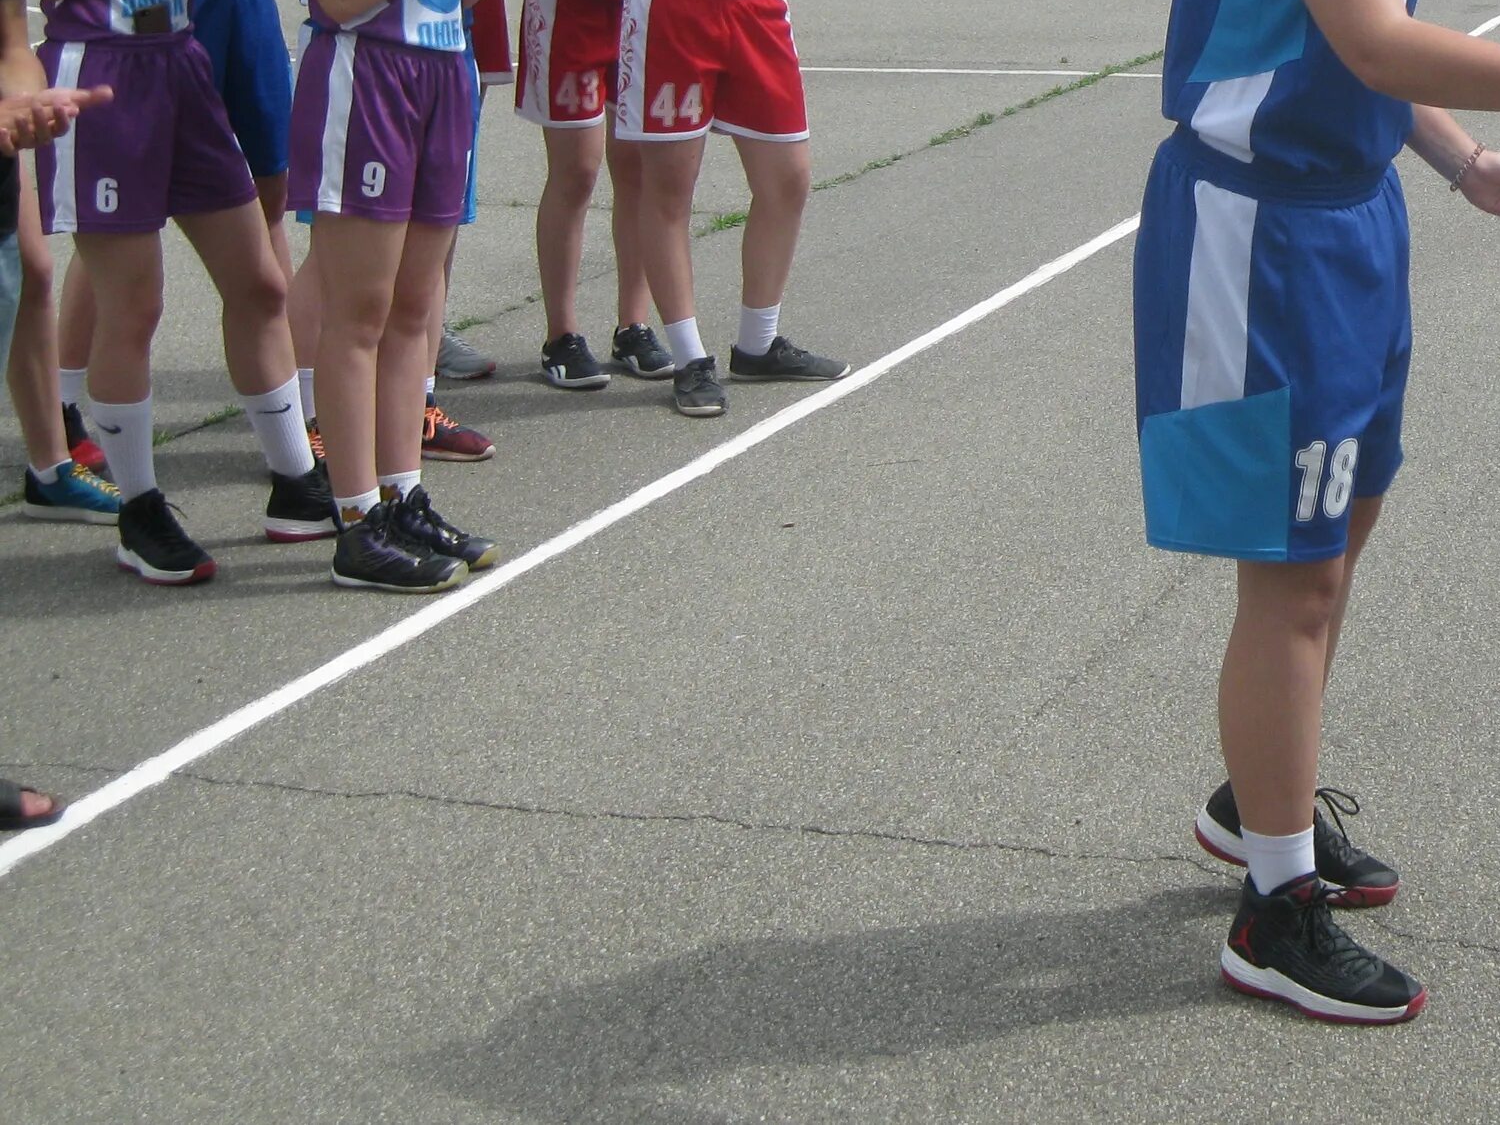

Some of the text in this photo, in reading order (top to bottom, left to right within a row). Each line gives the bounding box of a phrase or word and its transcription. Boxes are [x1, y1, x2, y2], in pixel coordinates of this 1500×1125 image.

[555, 69, 599, 115] 43
[651, 82, 703, 127] 44
[96, 177, 118, 213] 6
[361, 162, 386, 197] 9
[1295, 438, 1359, 521] 18
